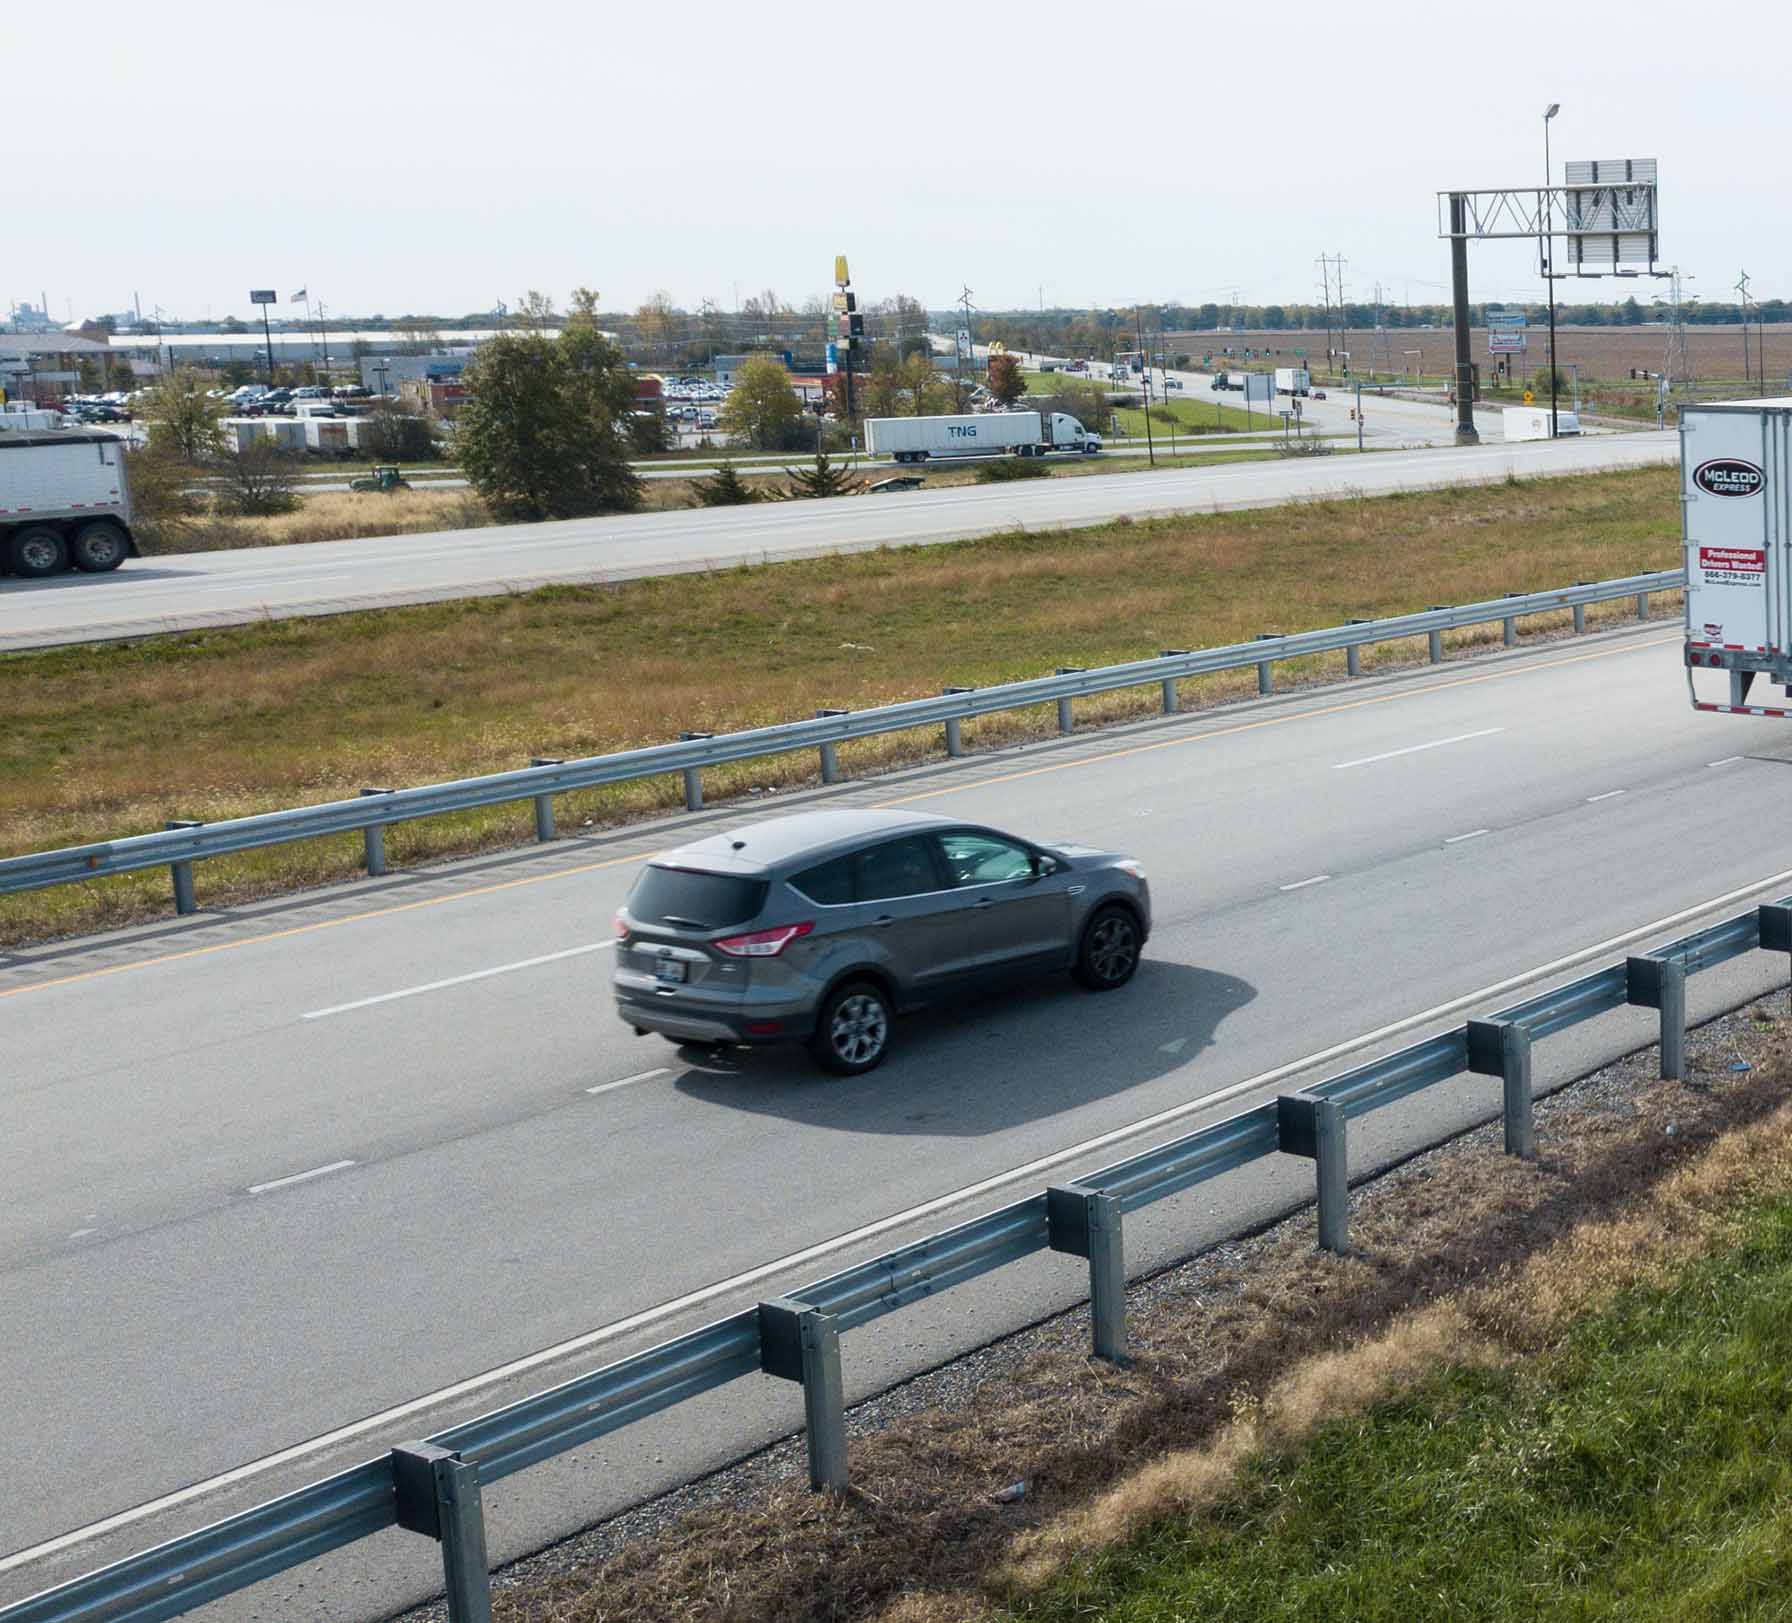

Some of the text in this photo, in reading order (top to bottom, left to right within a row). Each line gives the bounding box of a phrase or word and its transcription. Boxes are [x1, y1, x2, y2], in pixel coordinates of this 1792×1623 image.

[947, 425, 976, 438] TNG
[1713, 483, 1751, 492] EXPRESS
[1707, 549, 1757, 561] Professional
